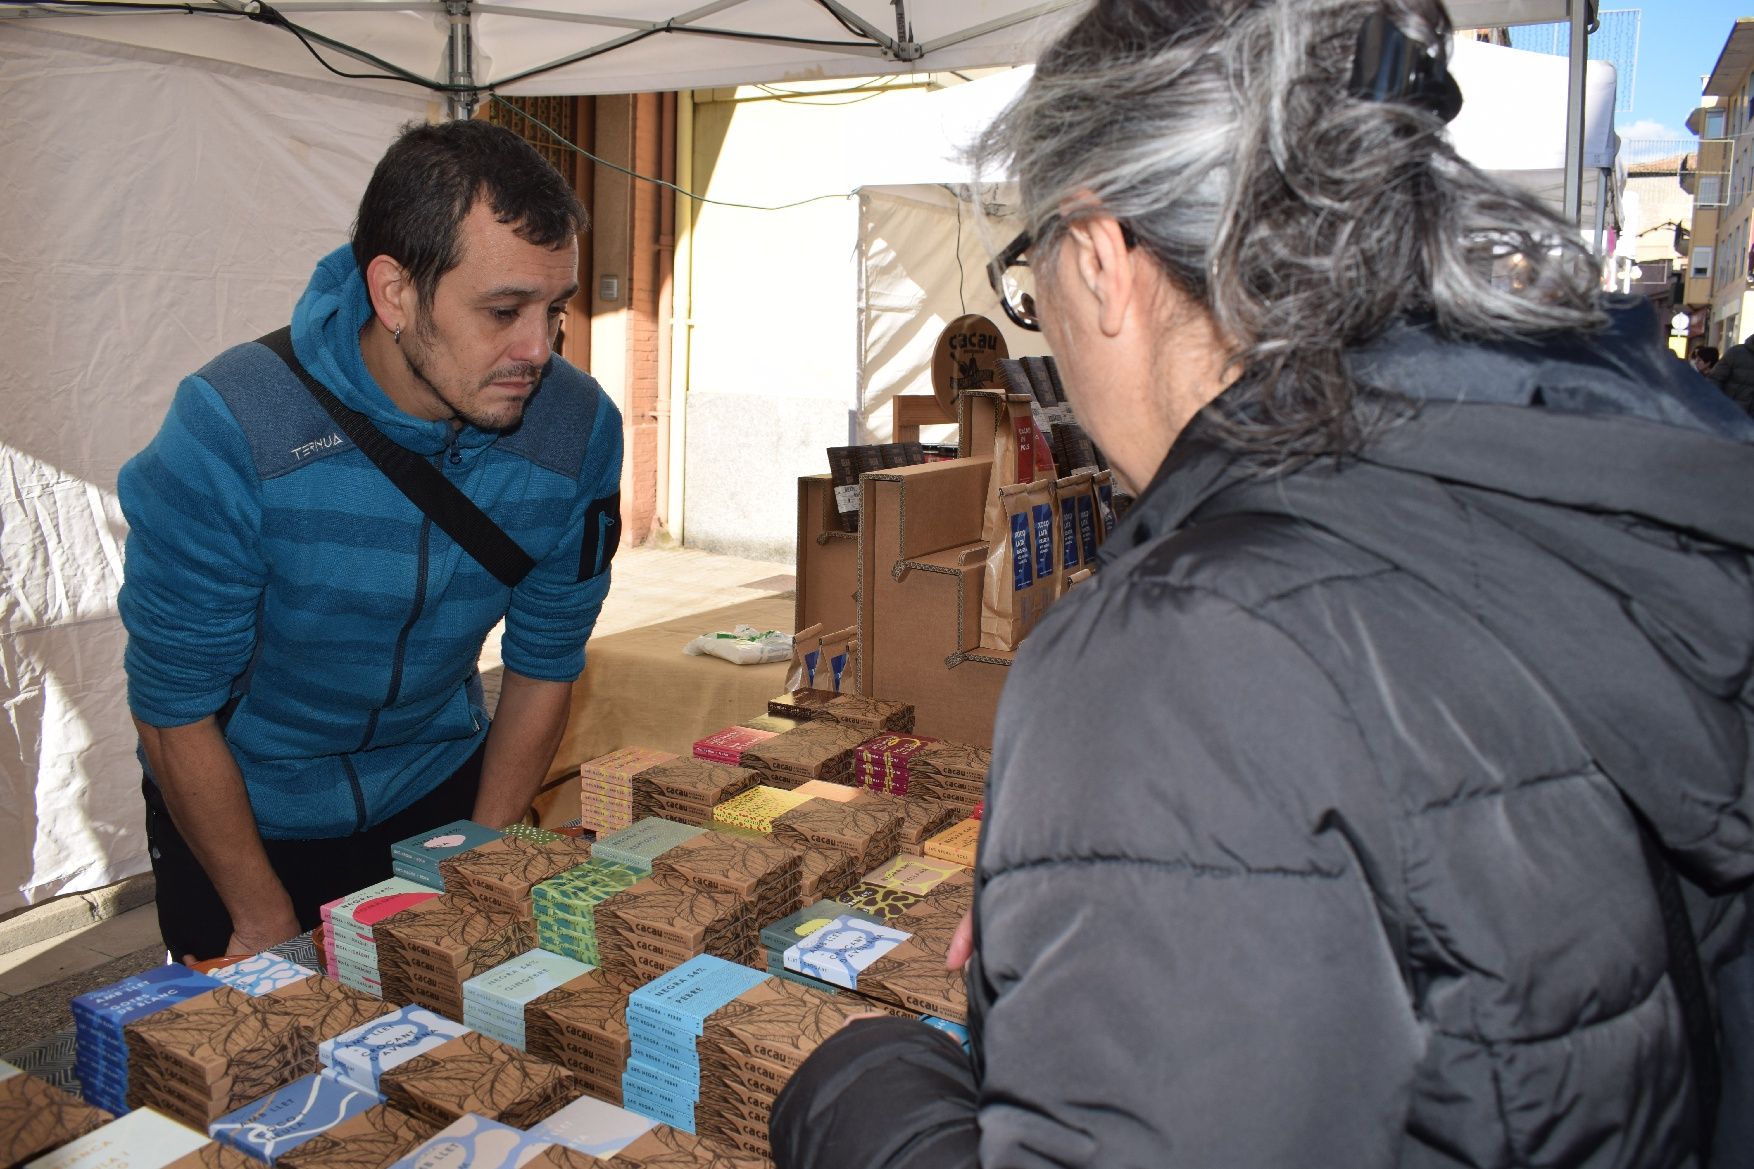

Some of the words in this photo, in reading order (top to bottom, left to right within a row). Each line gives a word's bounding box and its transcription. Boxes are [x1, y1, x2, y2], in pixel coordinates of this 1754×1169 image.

[949, 332, 997, 351] cacau
[291, 433, 343, 460] TERNUA
[841, 715, 860, 725] cacau
[772, 761, 793, 773] cacau
[943, 768, 966, 776] cacau
[771, 773, 791, 784] cacau
[945, 781, 966, 790] cacau
[666, 786, 688, 798] cacau
[942, 792, 965, 802] cacau
[666, 800, 688, 812] cacau
[811, 834, 836, 847] cacau
[472, 877, 494, 892] cacau
[692, 875, 719, 889] cacau
[479, 893, 501, 907] cacau
[636, 923, 663, 937] cacau
[407, 942, 430, 956] cacau
[637, 941, 664, 955] cacau
[411, 957, 435, 971] cacau
[638, 956, 665, 971] cacau
[413, 972, 437, 986] cacau
[95, 992, 121, 1004] AMB
[123, 980, 151, 996] LLET
[416, 987, 439, 1001] cacau
[654, 978, 687, 997] NEGRA
[675, 986, 704, 1004] PEBRE
[110, 994, 151, 1011] GOTES
[117, 1005, 134, 1015] DE
[136, 989, 178, 1007] BLANC
[906, 996, 938, 1012] cacau
[372, 1024, 395, 1037] LLET
[566, 1024, 592, 1041] cacau
[361, 1030, 415, 1057] CROCANT
[567, 1042, 594, 1059] cacau
[754, 1044, 786, 1063] cacau
[567, 1057, 595, 1074] cacau
[744, 1061, 775, 1080] cacau
[747, 1078, 778, 1096] cacau
[270, 1098, 294, 1113] LLET
[422, 1102, 449, 1121] cacau
[747, 1096, 772, 1112] caca
[748, 1110, 768, 1124] cac
[743, 1125, 768, 1141] caca
